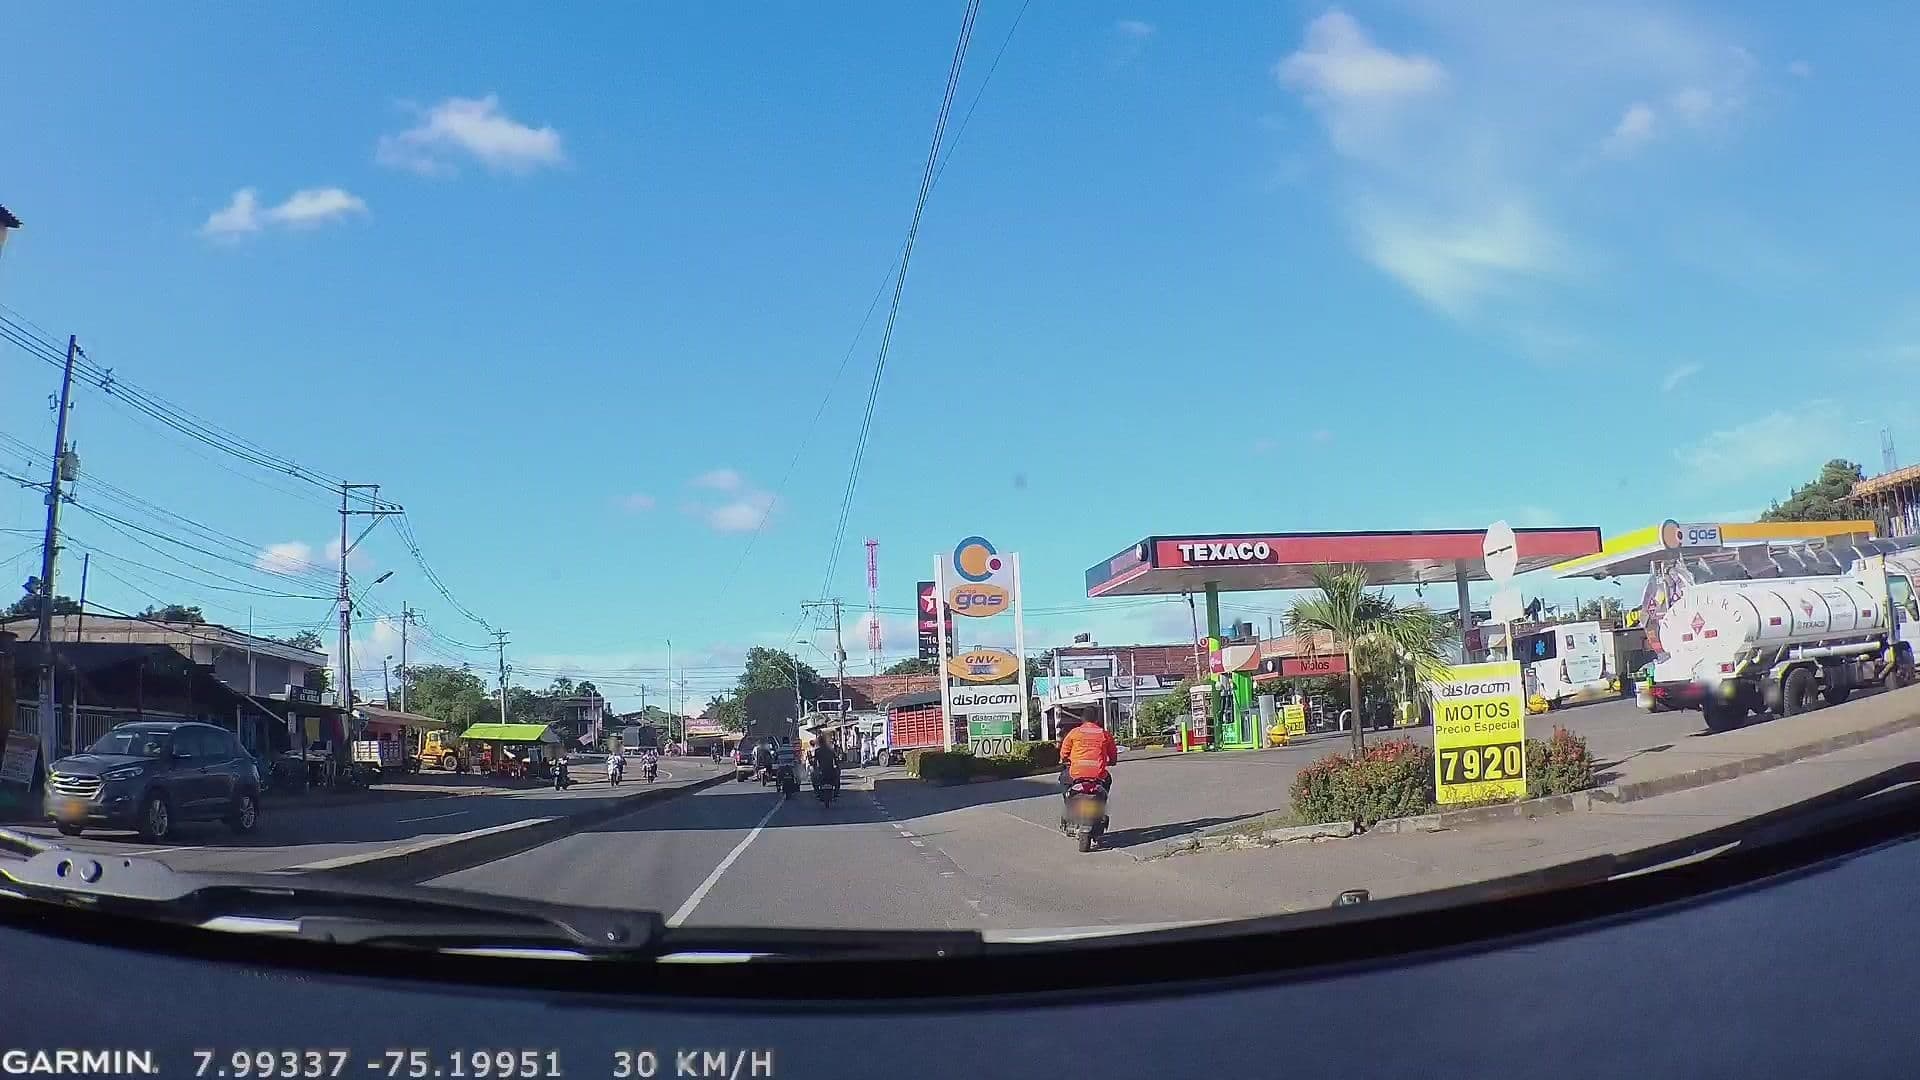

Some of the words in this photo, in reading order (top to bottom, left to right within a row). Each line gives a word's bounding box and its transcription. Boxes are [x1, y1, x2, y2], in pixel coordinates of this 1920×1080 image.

[1689, 529, 1717, 544] gas
[1179, 541, 1270, 562] TEXACO
[955, 594, 1003, 609] gas
[1441, 682, 1511, 697] distracom
[952, 693, 1018, 706] distracom
[971, 714, 1010, 722] distracom
[1445, 702, 1510, 721] MOTOS
[1436, 725, 1471, 735] Precio
[1474, 719, 1520, 733] Especial
[972, 738, 1013, 754] 7070
[1441, 745, 1521, 780] 7920
